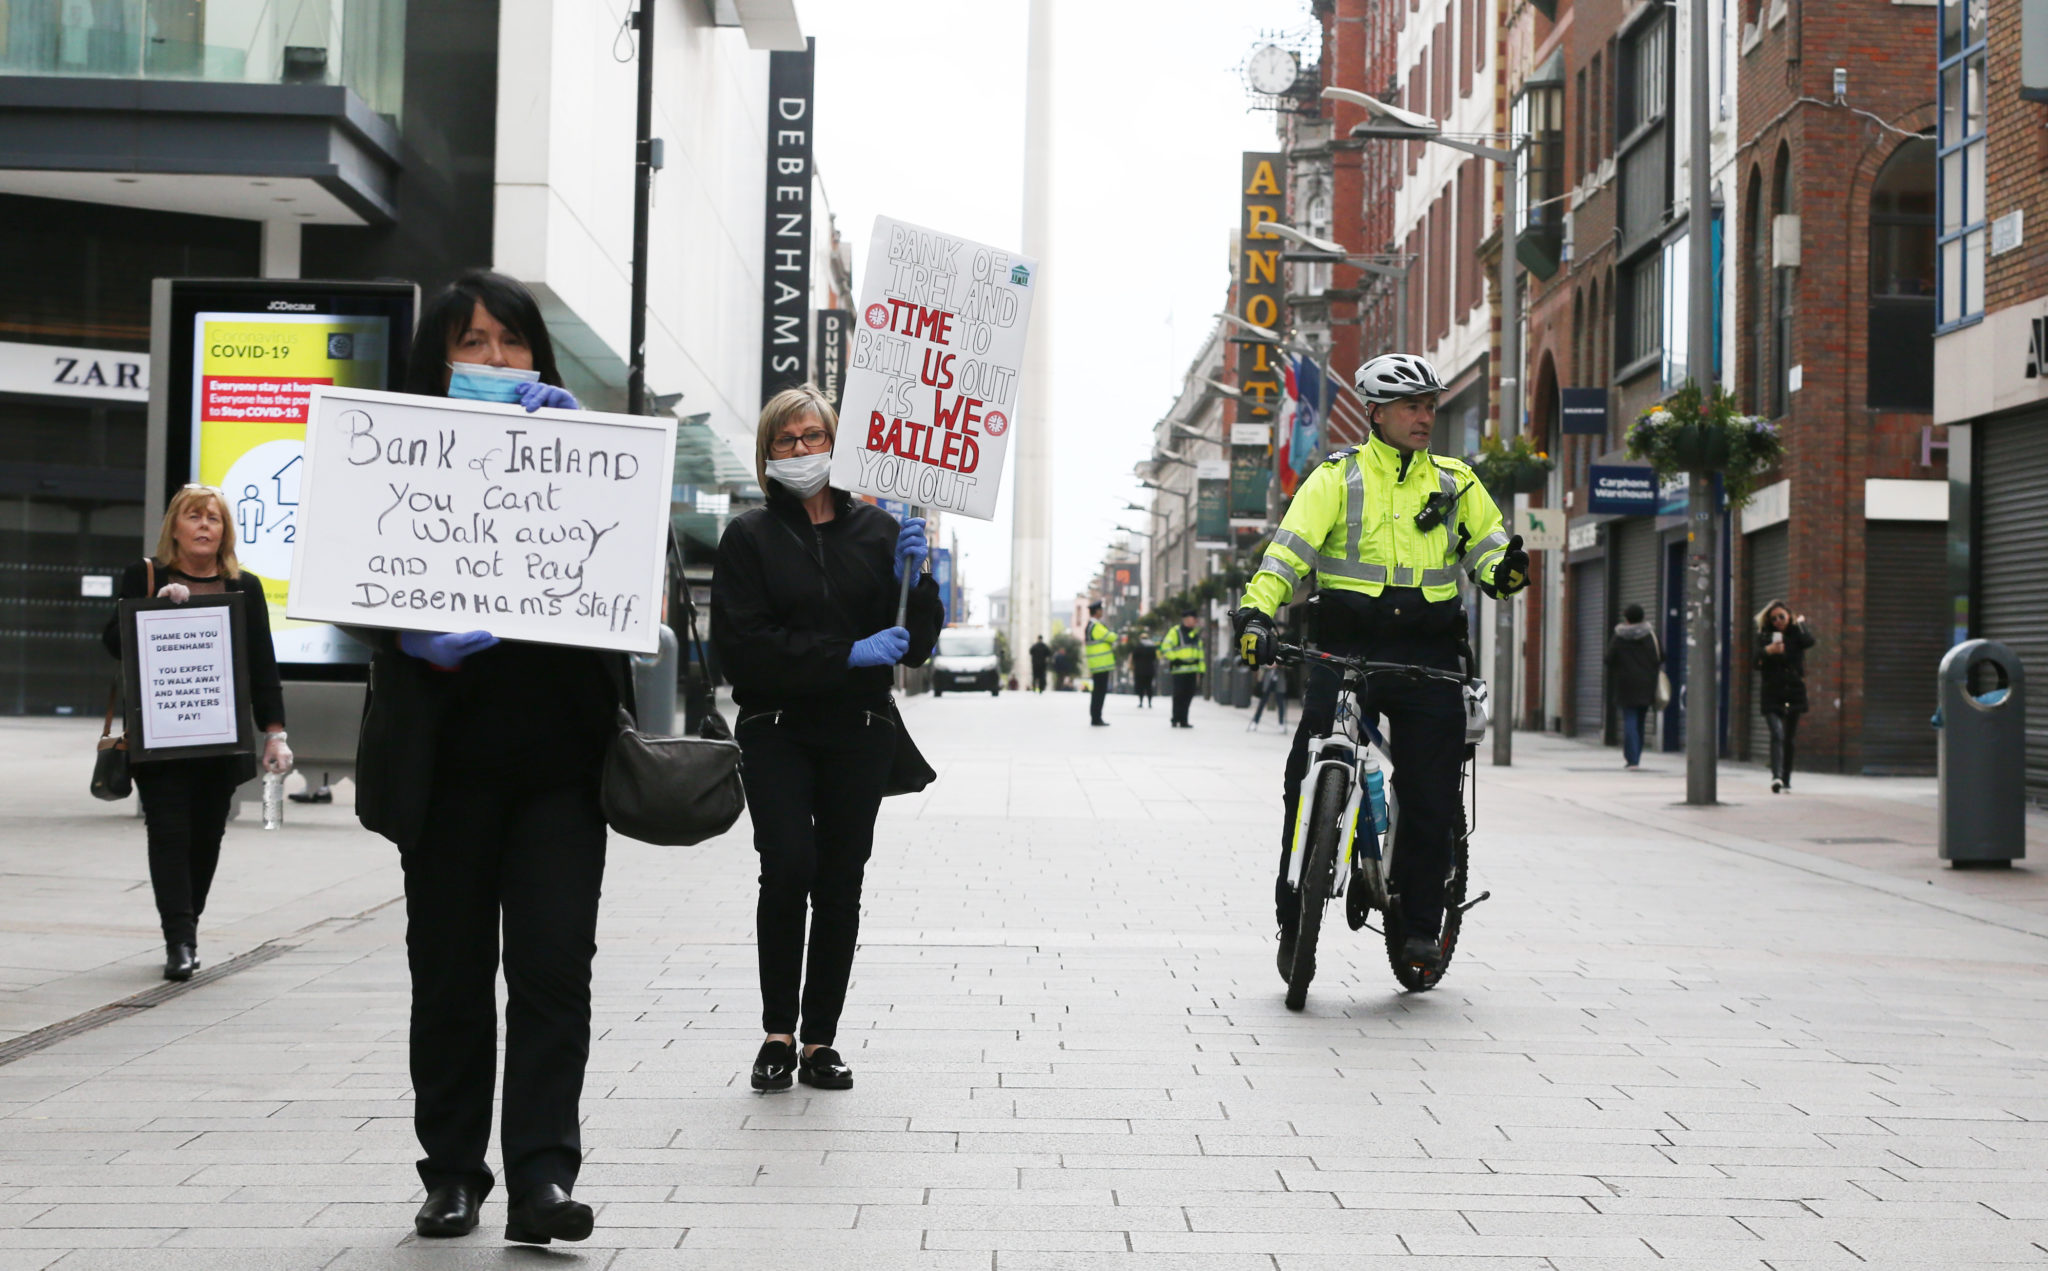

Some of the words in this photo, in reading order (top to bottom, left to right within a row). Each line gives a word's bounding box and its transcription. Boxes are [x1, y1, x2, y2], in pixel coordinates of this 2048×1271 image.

[772, 97, 806, 373] DEBENHAMS
[888, 224, 964, 274] BANK
[973, 248, 1009, 285] OF
[884, 258, 1018, 328] IRELAND
[267, 301, 316, 311] JCDecaux
[1245, 160, 1282, 457] ARNOTT
[888, 297, 954, 346] TIME
[960, 317, 992, 355] TO
[211, 329, 298, 344] Coronavirus
[211, 344, 290, 359] COVID-19
[826, 317, 839, 404] DUNNES
[853, 329, 916, 381] BAIL
[921, 348, 956, 389] US
[959, 359, 1016, 405] OUT
[53, 357, 149, 391] ZAR
[209, 380, 258, 393] Everyone
[258, 381, 280, 394] stay
[281, 382, 292, 392] at
[209, 393, 256, 406] Everyone
[256, 394, 274, 405] has
[274, 394, 291, 405] the
[875, 376, 916, 418] AS
[934, 389, 984, 437] WE
[209, 407, 220, 417] to
[220, 407, 244, 418] Stop
[245, 407, 302, 418] COVID-19.
[337, 409, 456, 470] Bank
[468, 448, 503, 481] of
[866, 410, 979, 474] BAILED
[856, 447, 917, 499] YOU
[918, 466, 977, 512] OUT
[1598, 477, 1650, 489] Carphone
[1594, 487, 1654, 499] Warehouse
[515, 519, 620, 562] away
[455, 550, 504, 578] not
[150, 632, 181, 641] SHAME
[199, 630, 218, 638] YOU
[156, 642, 213, 652] DEBENHAMS!
[159, 666, 177, 674] YOU
[179, 664, 214, 673] EXPECT
[167, 677, 193, 686] WALK
[195, 676, 221, 684] AWAY
[175, 687, 201, 696] MAKE
[203, 686, 221, 694] THE
[157, 701, 177, 710] TAX
[180, 698, 220, 708] PAYERS
[178, 712, 201, 722] PAY!
